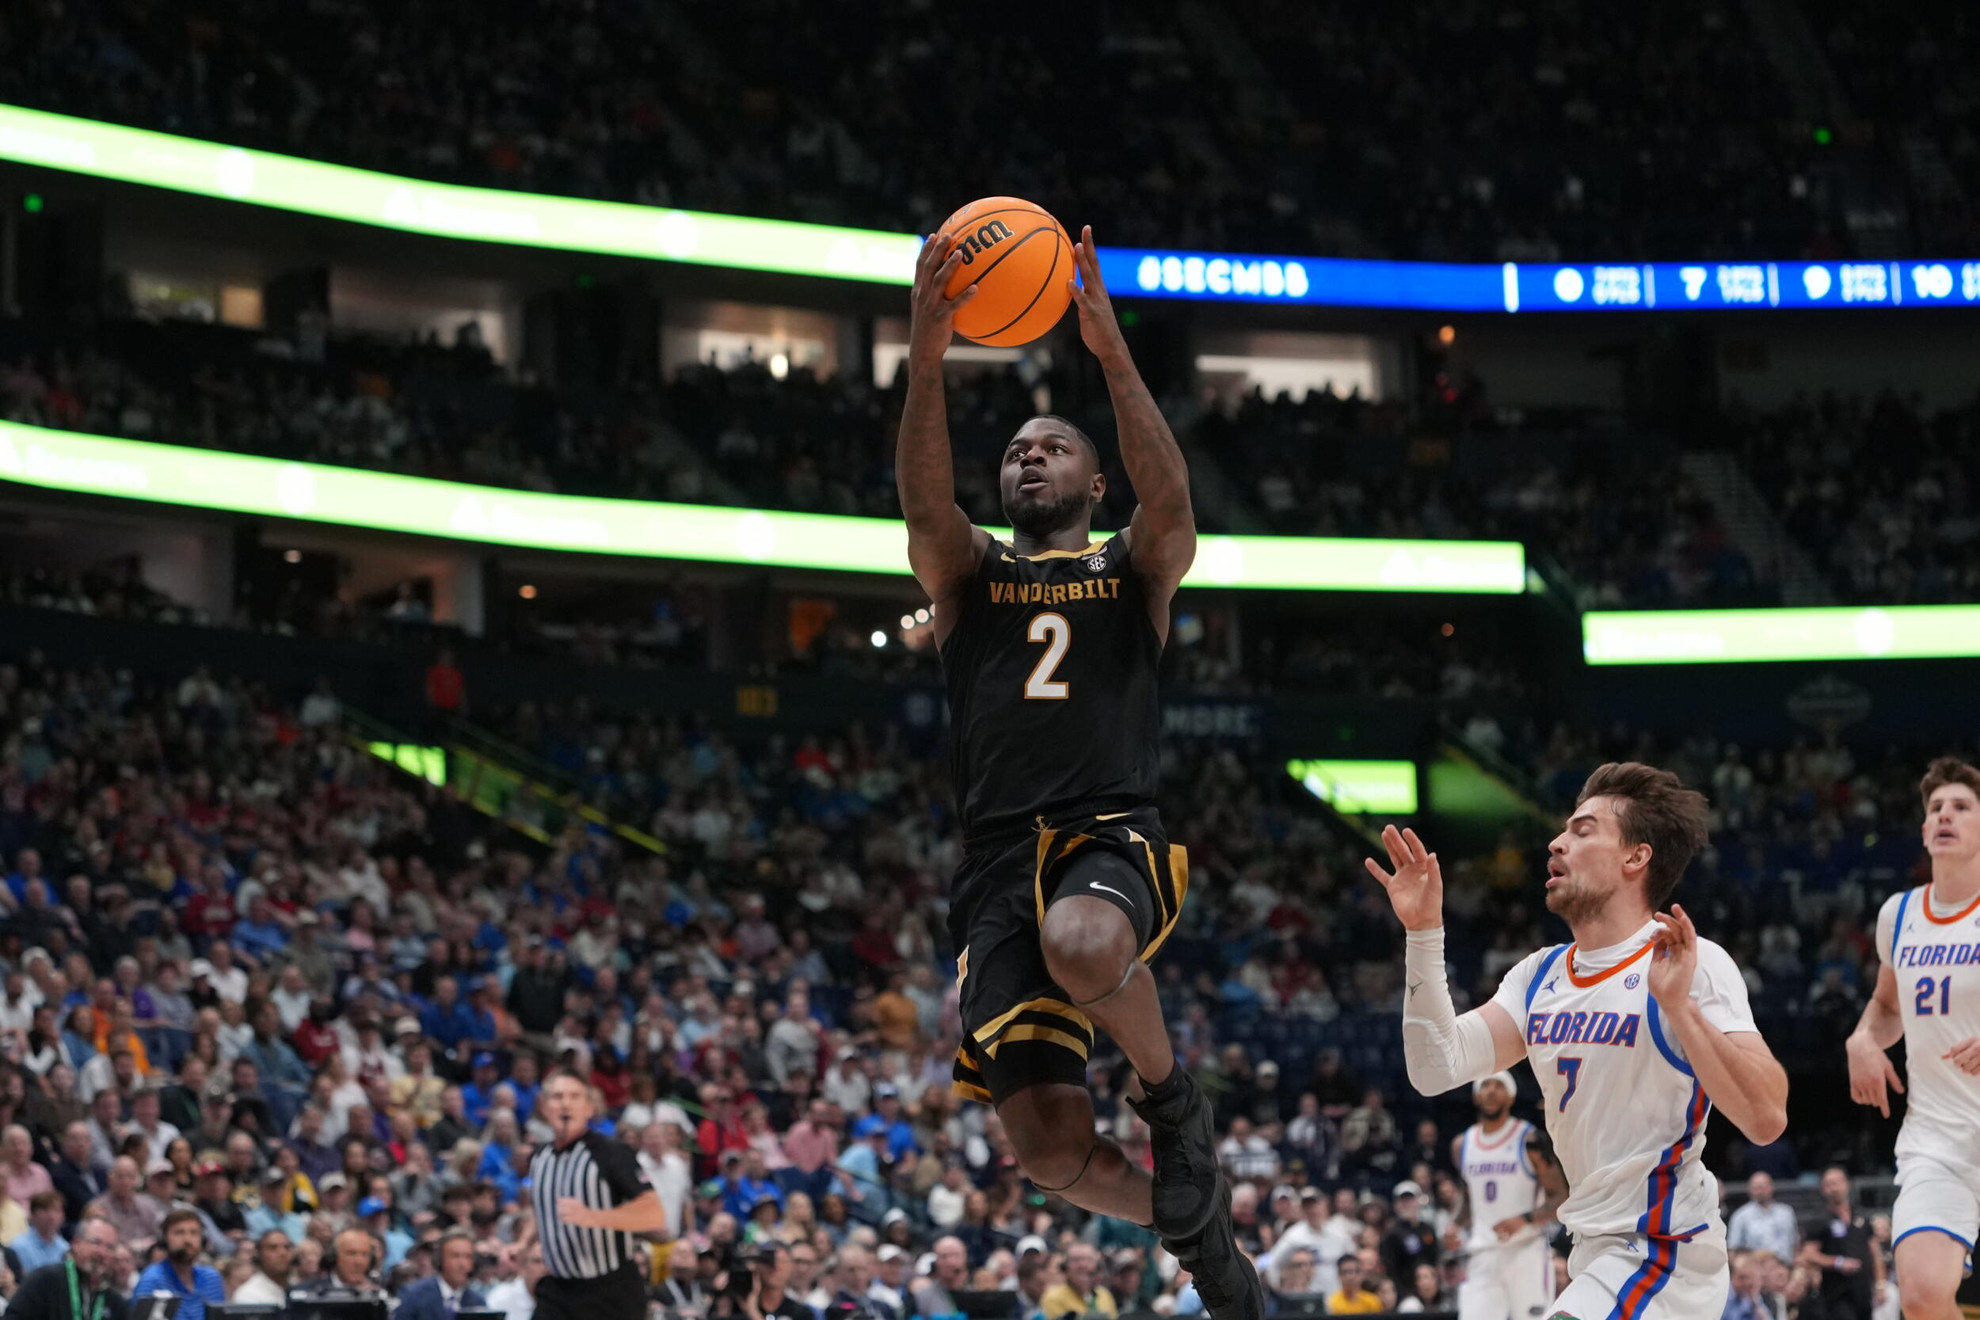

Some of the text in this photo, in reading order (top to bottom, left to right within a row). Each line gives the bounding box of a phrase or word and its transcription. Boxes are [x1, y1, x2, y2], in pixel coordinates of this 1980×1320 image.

[1088, 556, 1105, 571] SEC
[990, 578, 1120, 604] VANDERBILT
[1024, 612, 1071, 699] 2
[1915, 975, 1951, 1016] 21
[1527, 1011, 1641, 1048] FLORIDA
[1557, 1056, 1582, 1113] 7
[1485, 1180, 1497, 1203] 0
